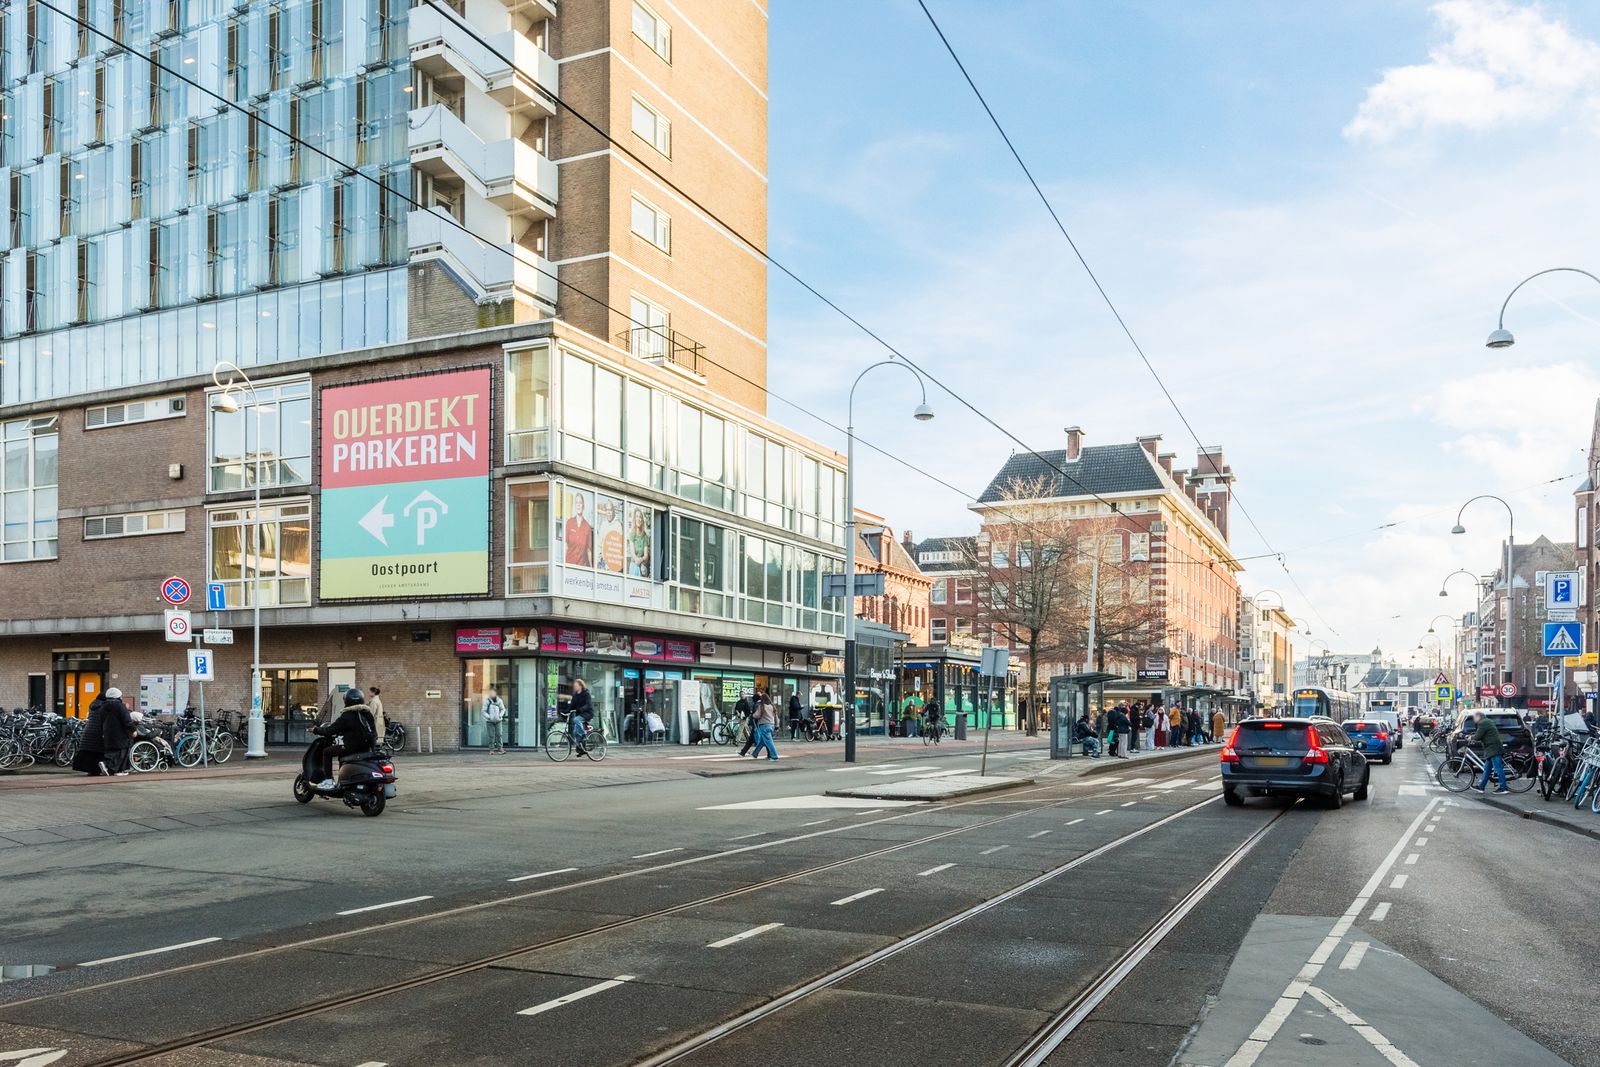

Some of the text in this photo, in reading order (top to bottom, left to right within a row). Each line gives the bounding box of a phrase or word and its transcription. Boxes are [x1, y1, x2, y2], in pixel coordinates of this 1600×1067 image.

[333, 394, 480, 440] OVERDEKT
[333, 430, 476, 473] PARKEREN
[371, 561, 438, 577] Oostpoort
[631, 587, 651, 597] AMSTA
[1557, 582, 1568, 593] P
[197, 658, 205, 667] P
[1503, 686, 1513, 694] 30
